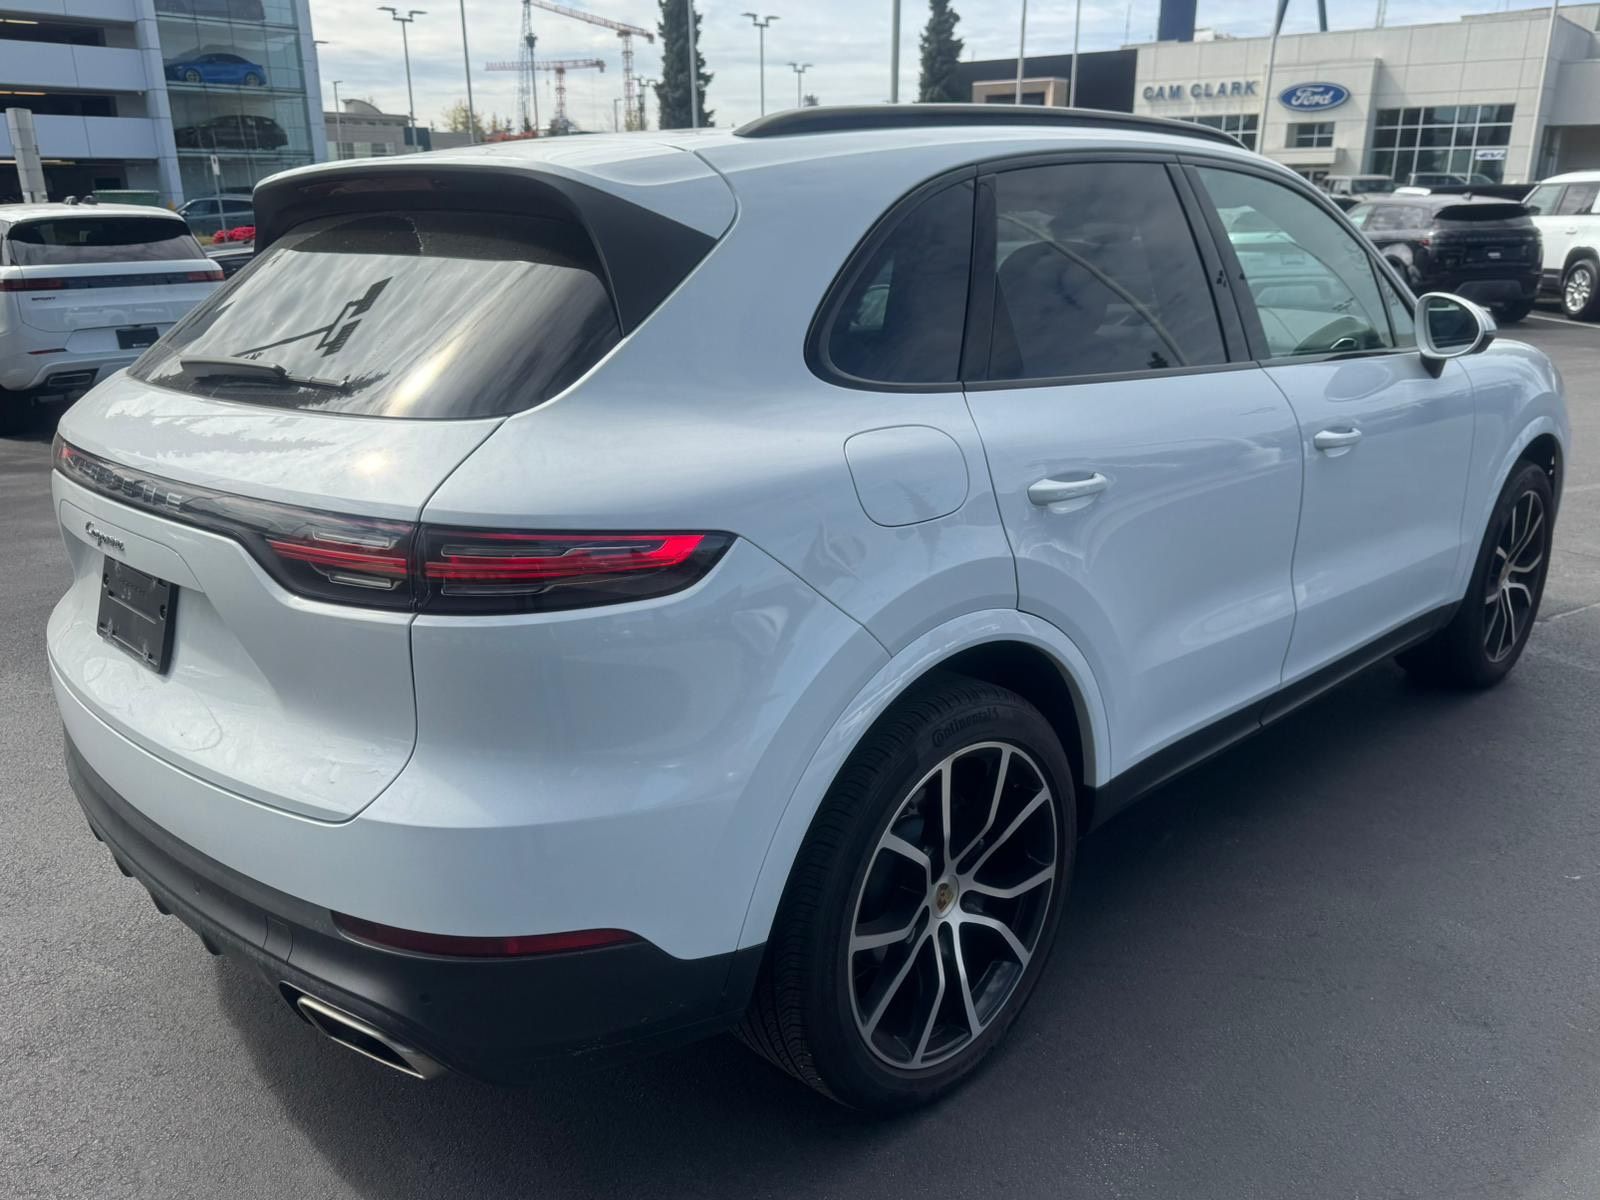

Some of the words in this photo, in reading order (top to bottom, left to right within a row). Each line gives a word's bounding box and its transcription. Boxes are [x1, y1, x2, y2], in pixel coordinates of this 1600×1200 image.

[1143, 85, 1182, 100] CAM
[1190, 81, 1259, 98] CLARK
[1291, 87, 1334, 106] Ford
